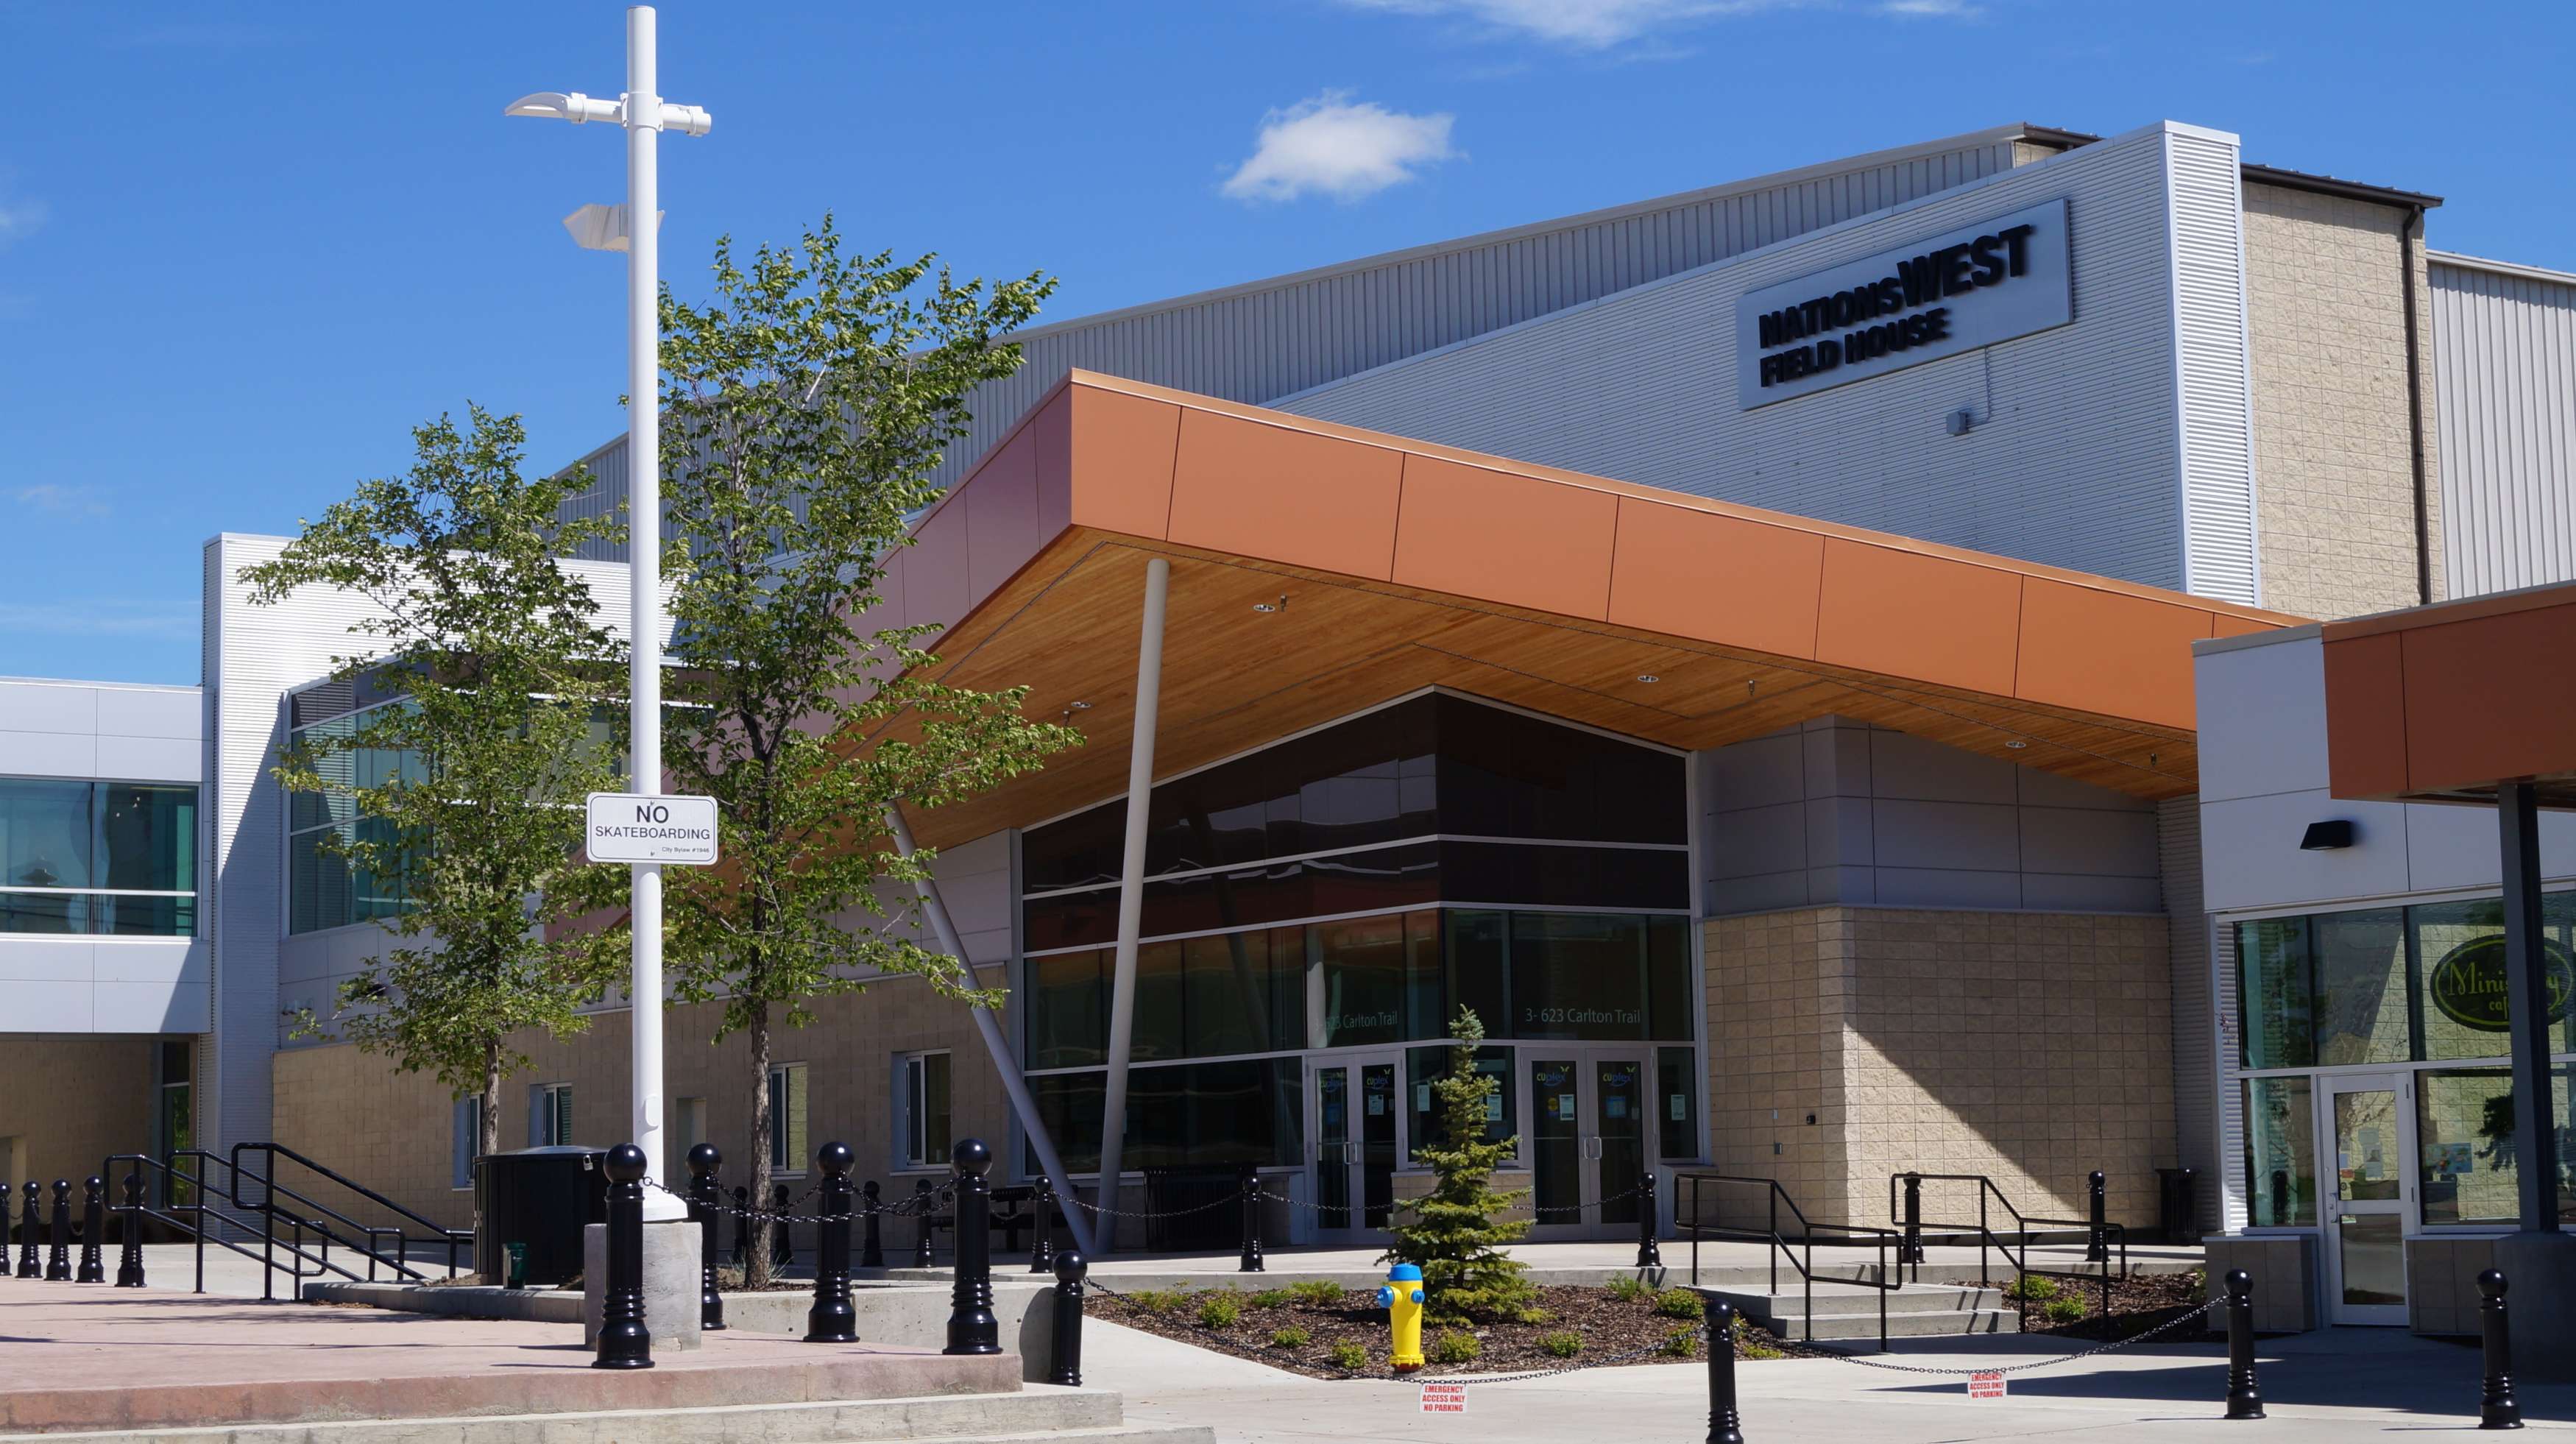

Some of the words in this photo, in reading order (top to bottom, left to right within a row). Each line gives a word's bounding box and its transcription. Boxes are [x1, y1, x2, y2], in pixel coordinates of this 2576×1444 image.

[1760, 339, 1841, 388] FIELD
[1844, 307, 1950, 364] HOUSE
[636, 805, 669, 824] NO
[595, 826, 710, 840] SKATEBOARDING
[1343, 1013, 1377, 1028] Carlton
[1378, 1011, 1398, 1025] Trail
[1526, 1008, 1537, 1022] 3-
[1541, 1008, 1563, 1022] 623
[1568, 1008, 1612, 1023] Carlton
[1615, 1010, 1641, 1023] Trail
[1425, 1385, 1463, 1393] EMERGENCY
